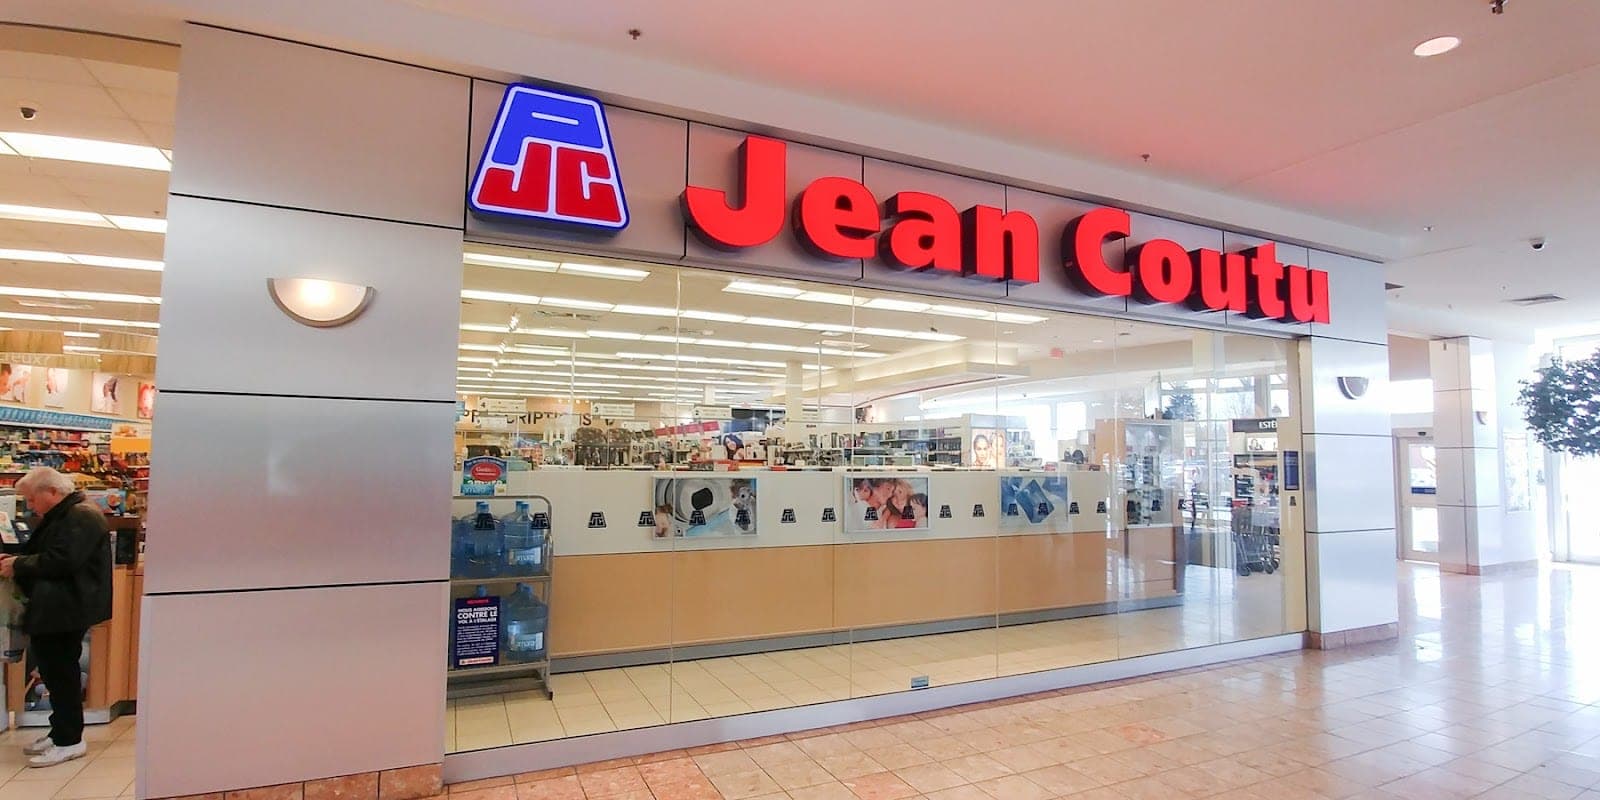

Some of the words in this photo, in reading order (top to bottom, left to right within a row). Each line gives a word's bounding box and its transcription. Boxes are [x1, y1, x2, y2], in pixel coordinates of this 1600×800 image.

[683, 135, 1040, 284] Jean
[1066, 207, 1330, 325] Coutu
[457, 612, 489, 620] CONTRE
